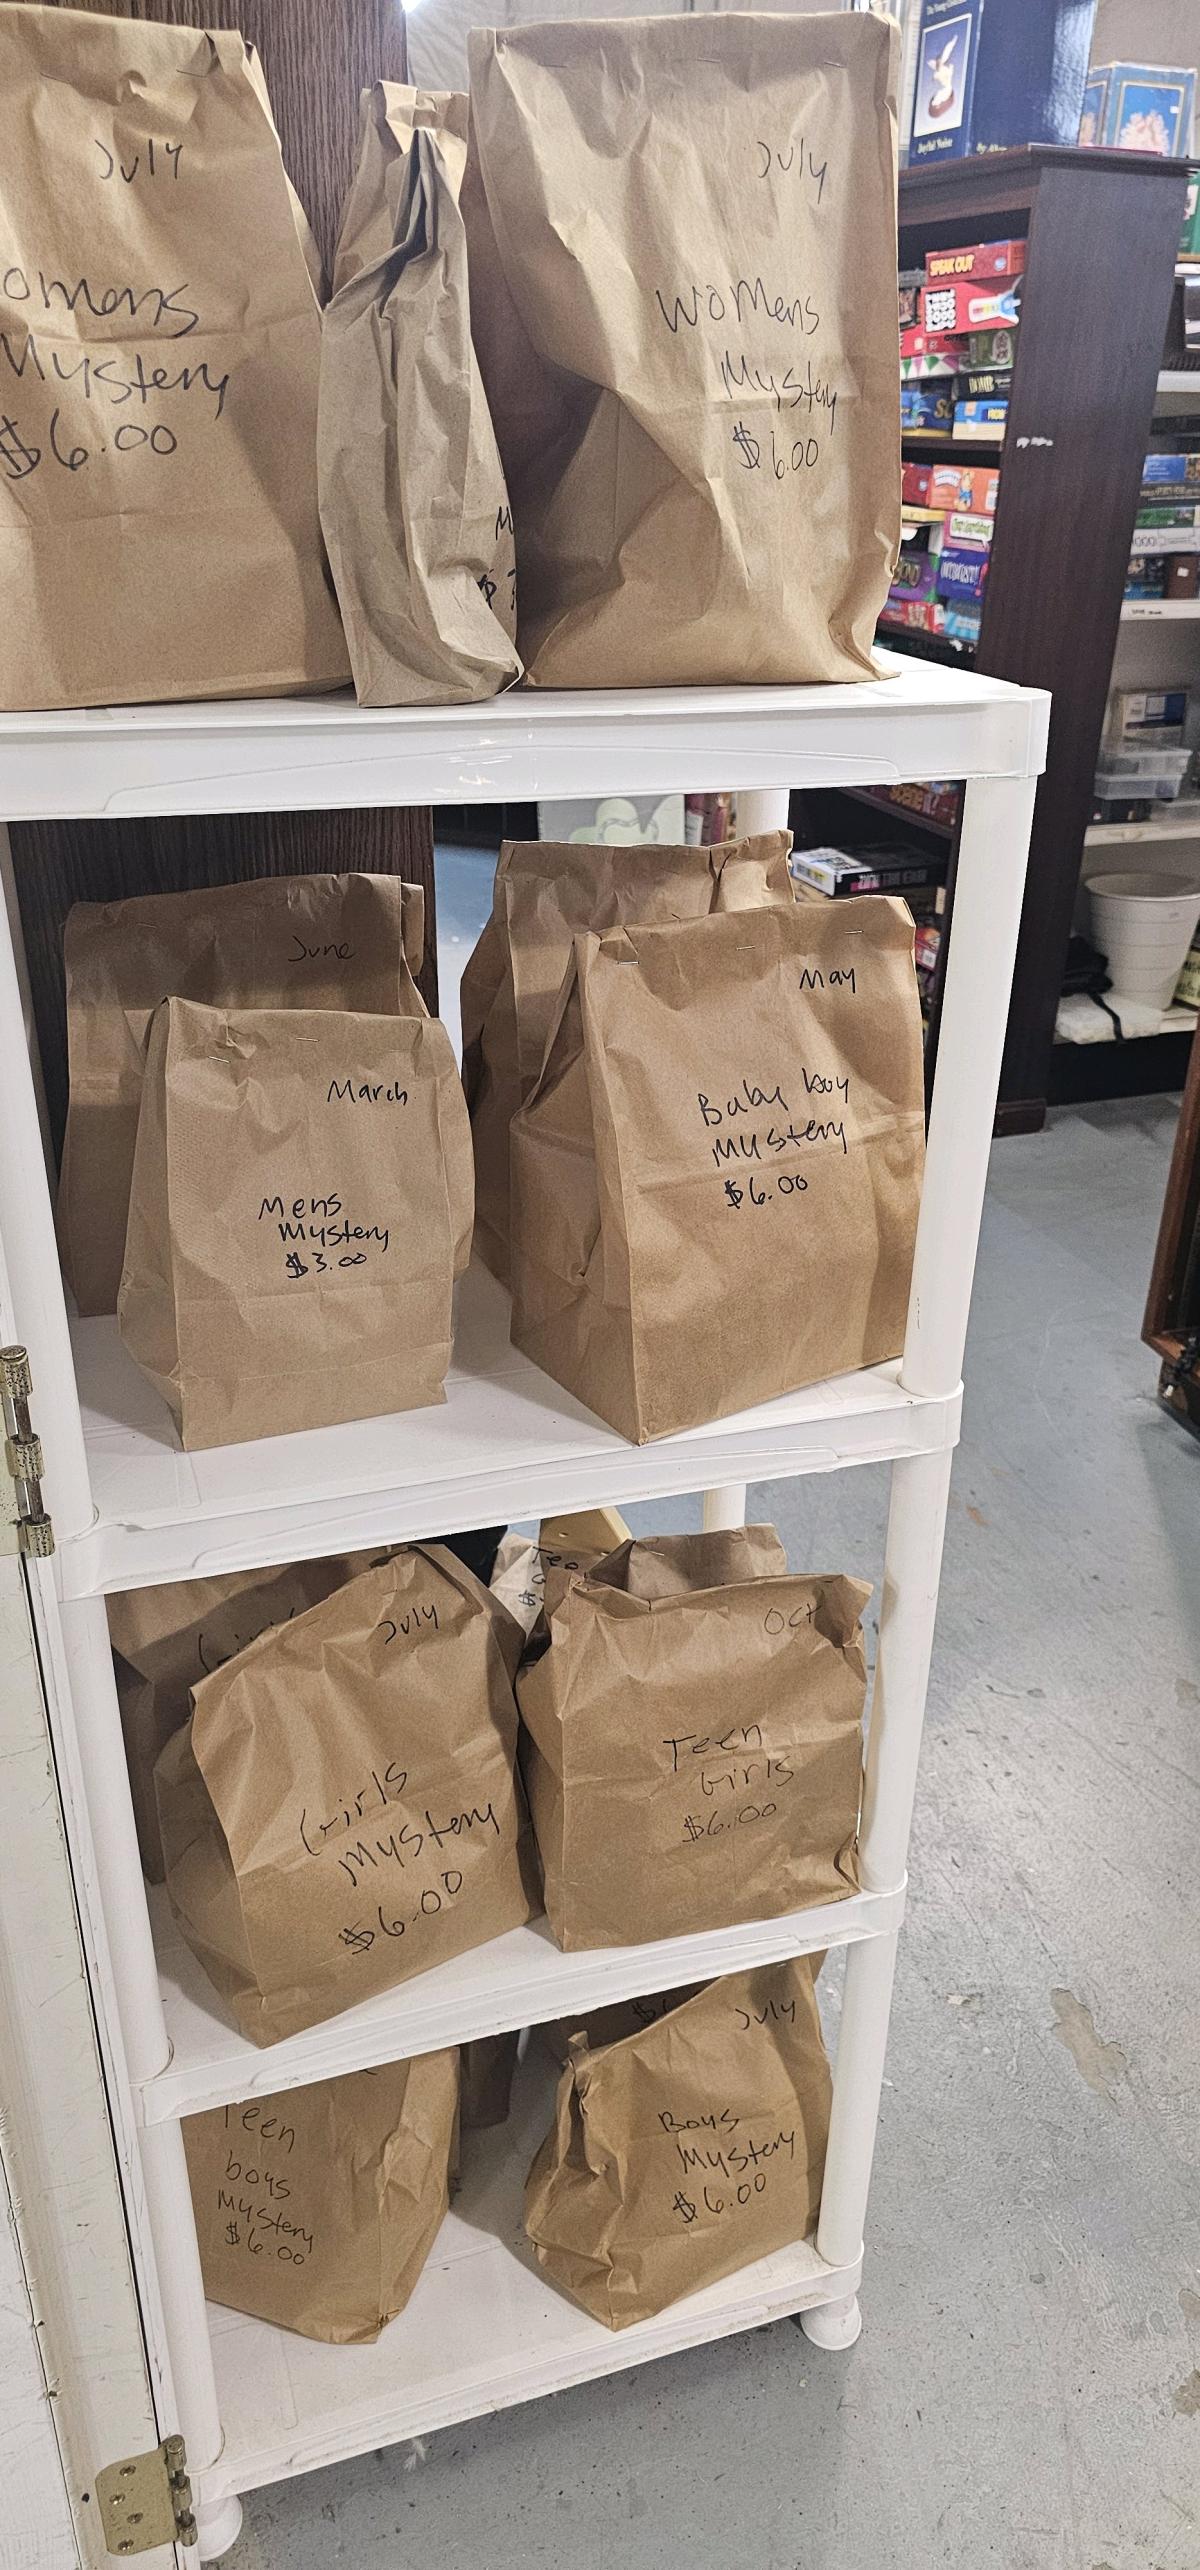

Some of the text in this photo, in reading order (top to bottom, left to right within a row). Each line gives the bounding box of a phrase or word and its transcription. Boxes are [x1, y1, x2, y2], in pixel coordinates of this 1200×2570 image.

[95, 139, 183, 182] July
[757, 138, 828, 204] July
[0, 333, 229, 420] Mystery
[721, 350, 837, 434] Mystery
[288, 936, 355, 961] June
[800, 968, 856, 993] May
[328, 1080, 409, 1106] March
[697, 1080, 789, 1126] Baby
[259, 1194, 342, 1219] Mens
[725, 1173, 808, 1209] $6.00
[286, 1251, 367, 1279] $3.00
[379, 1604, 440, 1644] July
[764, 1602, 824, 1635] Oct
[663, 1724, 763, 1772] Teen
[682, 1802, 778, 1844] $6.00
[338, 1804, 500, 1886] Mystery
[338, 1870, 464, 1955] $6.00
[735, 2000, 796, 2030] July
[658, 2108, 740, 2133] Boys
[677, 2130, 796, 2178] Mystery
[672, 2173, 767, 2224] $6.00
[225, 2221, 306, 2265] $6.00
